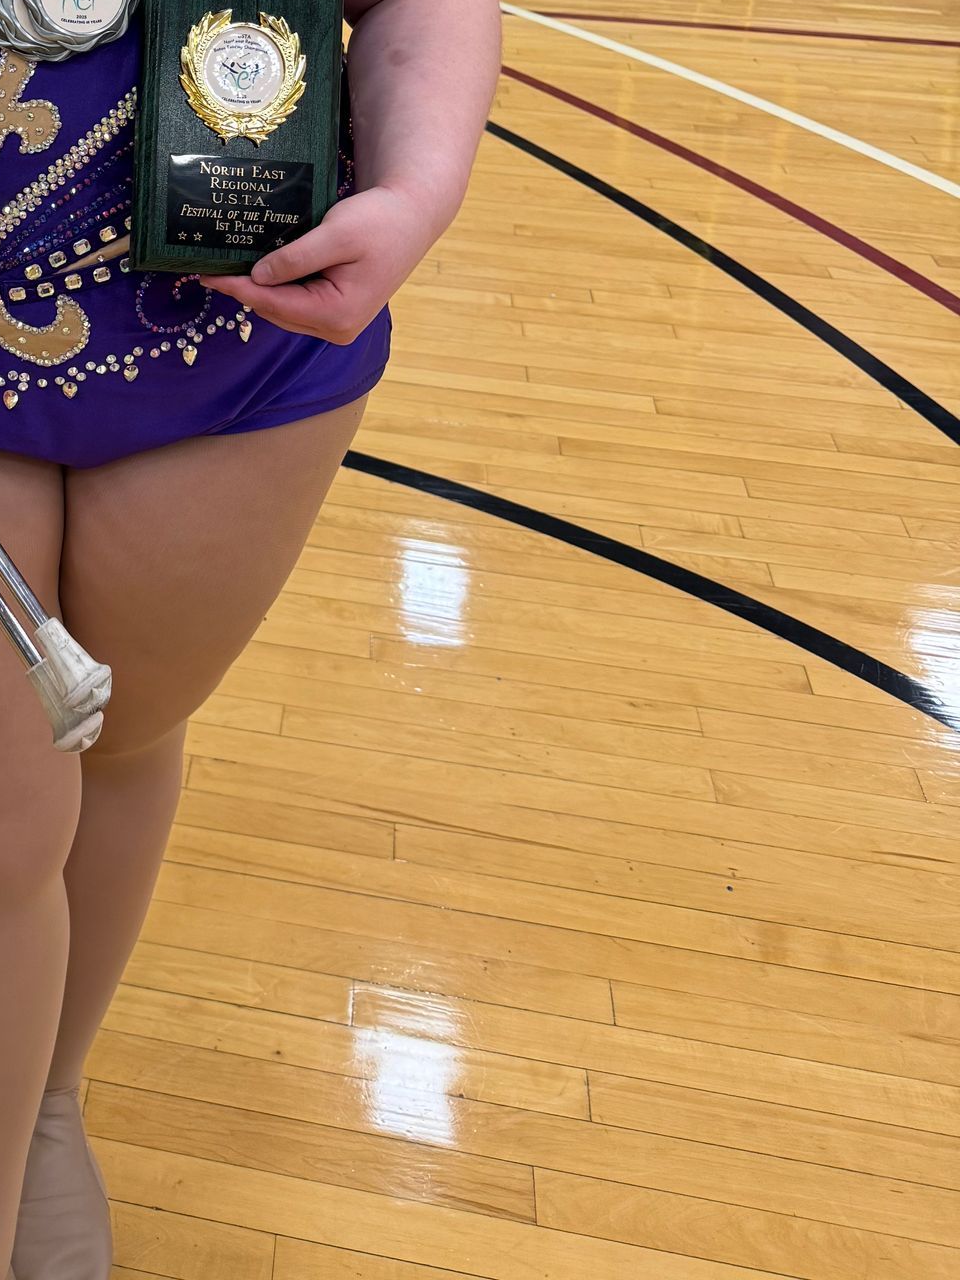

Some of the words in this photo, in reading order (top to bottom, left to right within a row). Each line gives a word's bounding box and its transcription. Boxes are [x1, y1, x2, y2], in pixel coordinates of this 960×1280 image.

[200, 161, 244, 177] NORTH
[252, 166, 286, 180] EAST
[210, 176, 274, 193] REGIONAL
[212, 192, 270, 207] U.S.T.A.
[180, 204, 224, 219] FESTIVAL
[227, 210, 240, 220] OF
[243, 211, 261, 220] THE
[264, 210, 299, 224] FUTURE
[234, 220, 265, 233] PLACE
[225, 234, 254, 245] 2025
